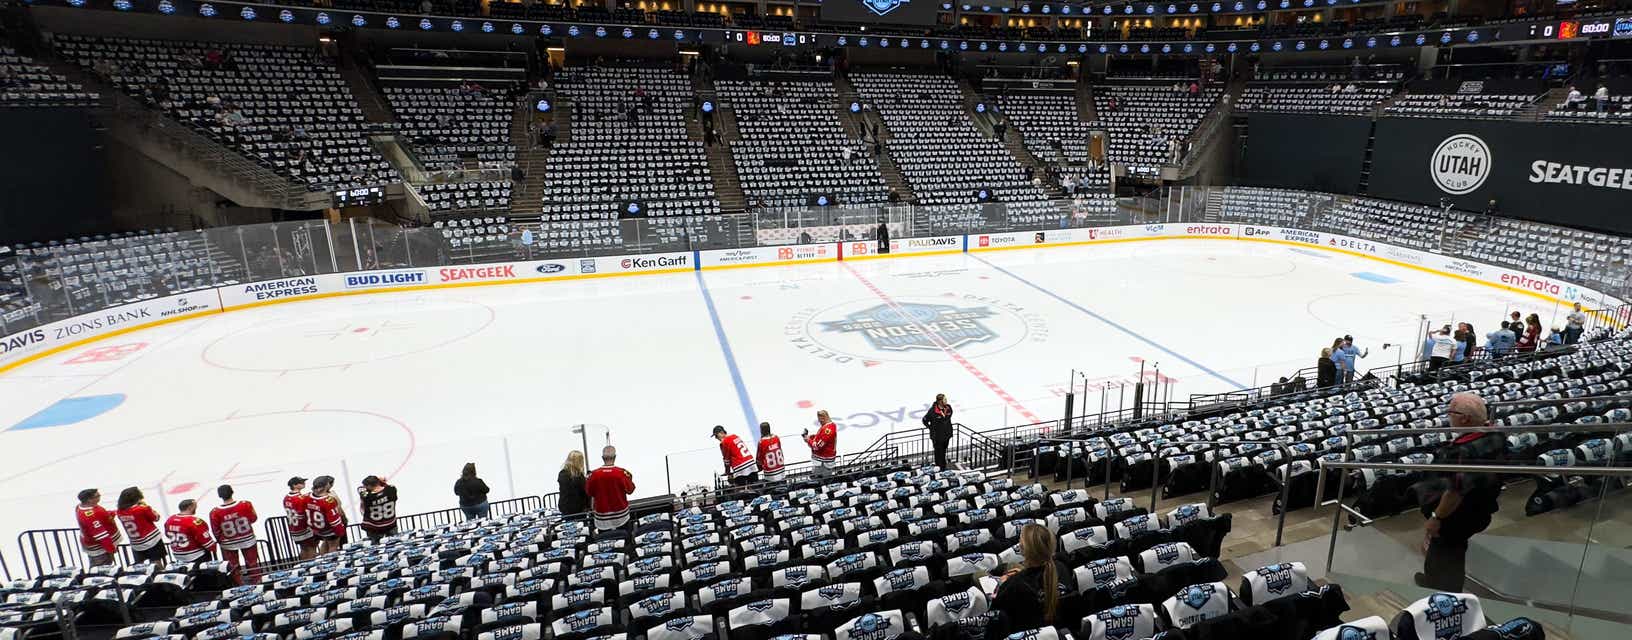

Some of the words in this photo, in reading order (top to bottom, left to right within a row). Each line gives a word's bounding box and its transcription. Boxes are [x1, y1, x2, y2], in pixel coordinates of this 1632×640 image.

[1543, 25, 1553, 37] 0
[1581, 23, 1610, 33] 60:00
[1447, 140, 1480, 154] HOCKEY
[1439, 154, 1482, 177] UTAH
[1445, 178, 1468, 188] CLUB
[1186, 224, 1231, 235] entrata
[1279, 228, 1320, 239] AMERICAN
[991, 236, 1016, 244] TOYOTA
[1284, 234, 1320, 245] EXPRESS
[1340, 238, 1376, 254] DELTA
[632, 258, 656, 269] Ken
[657, 255, 687, 267] Garff
[347, 275, 380, 287] BUD
[381, 272, 424, 284] LIGHT
[440, 264, 516, 283] SEATGEEK
[244, 277, 315, 294] AMERICAN
[1500, 271, 1560, 295] entrata
[256, 285, 318, 301] EXPRESS
[54, 318, 102, 340] ZIONS
[106, 307, 151, 325] BANK
[868, 319, 978, 339] SEASON
[766, 449, 785, 468] 88
[369, 501, 395, 521] 88
[305, 509, 325, 529] 19
[125, 521, 140, 538] 2
[221, 517, 251, 537] 88
[899, 543, 920, 551] GAME
[1156, 544, 1178, 555] GAME
[695, 566, 715, 576] GAME
[843, 560, 864, 573] GAME
[1092, 563, 1115, 575] GAME
[634, 576, 655, 586] GAME
[890, 571, 914, 585] GAME
[1266, 570, 1290, 582] GAME
[520, 584, 541, 593] GAME
[715, 584, 737, 594] GAME
[567, 592, 590, 603] GAME
[942, 591, 968, 603] GAME
[497, 606, 521, 616] GAME
[648, 600, 669, 611] GAME
[419, 622, 444, 631] GAME
[571, 616, 597, 630] GAME
[1106, 616, 1134, 630] GAME
[1436, 614, 1461, 630] GAME
[495, 625, 522, 638] GAME
